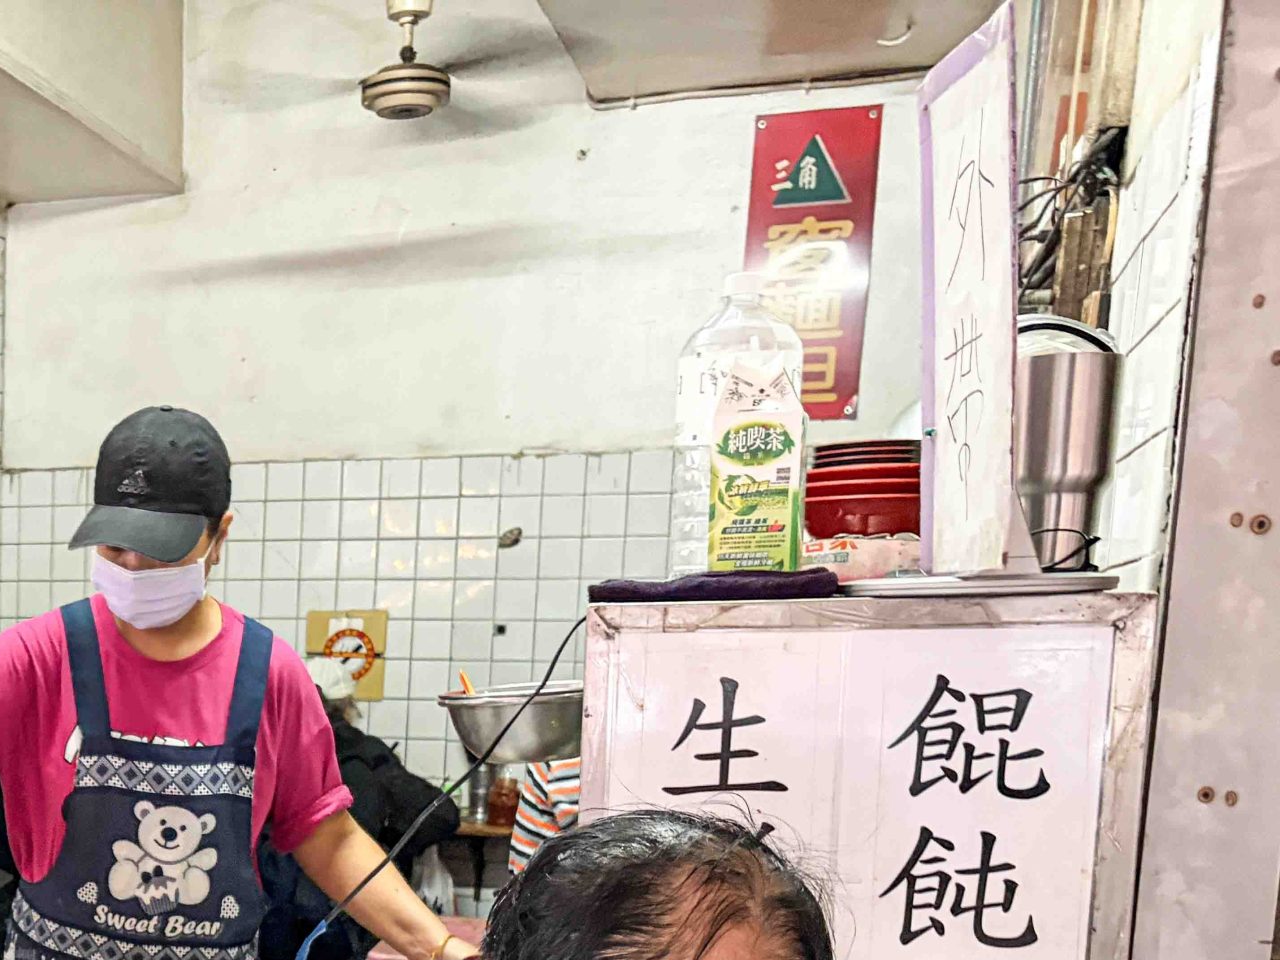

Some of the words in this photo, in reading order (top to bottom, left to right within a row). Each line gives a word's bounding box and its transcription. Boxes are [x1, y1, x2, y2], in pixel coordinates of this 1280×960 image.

[770, 156, 818, 192] 三角
[728, 426, 785, 453] 純喫茶
[661, 676, 789, 840] 生
[879, 673, 1051, 949] 餛飩
[93, 904, 159, 934] Sweet
[164, 915, 222, 937] Bear
